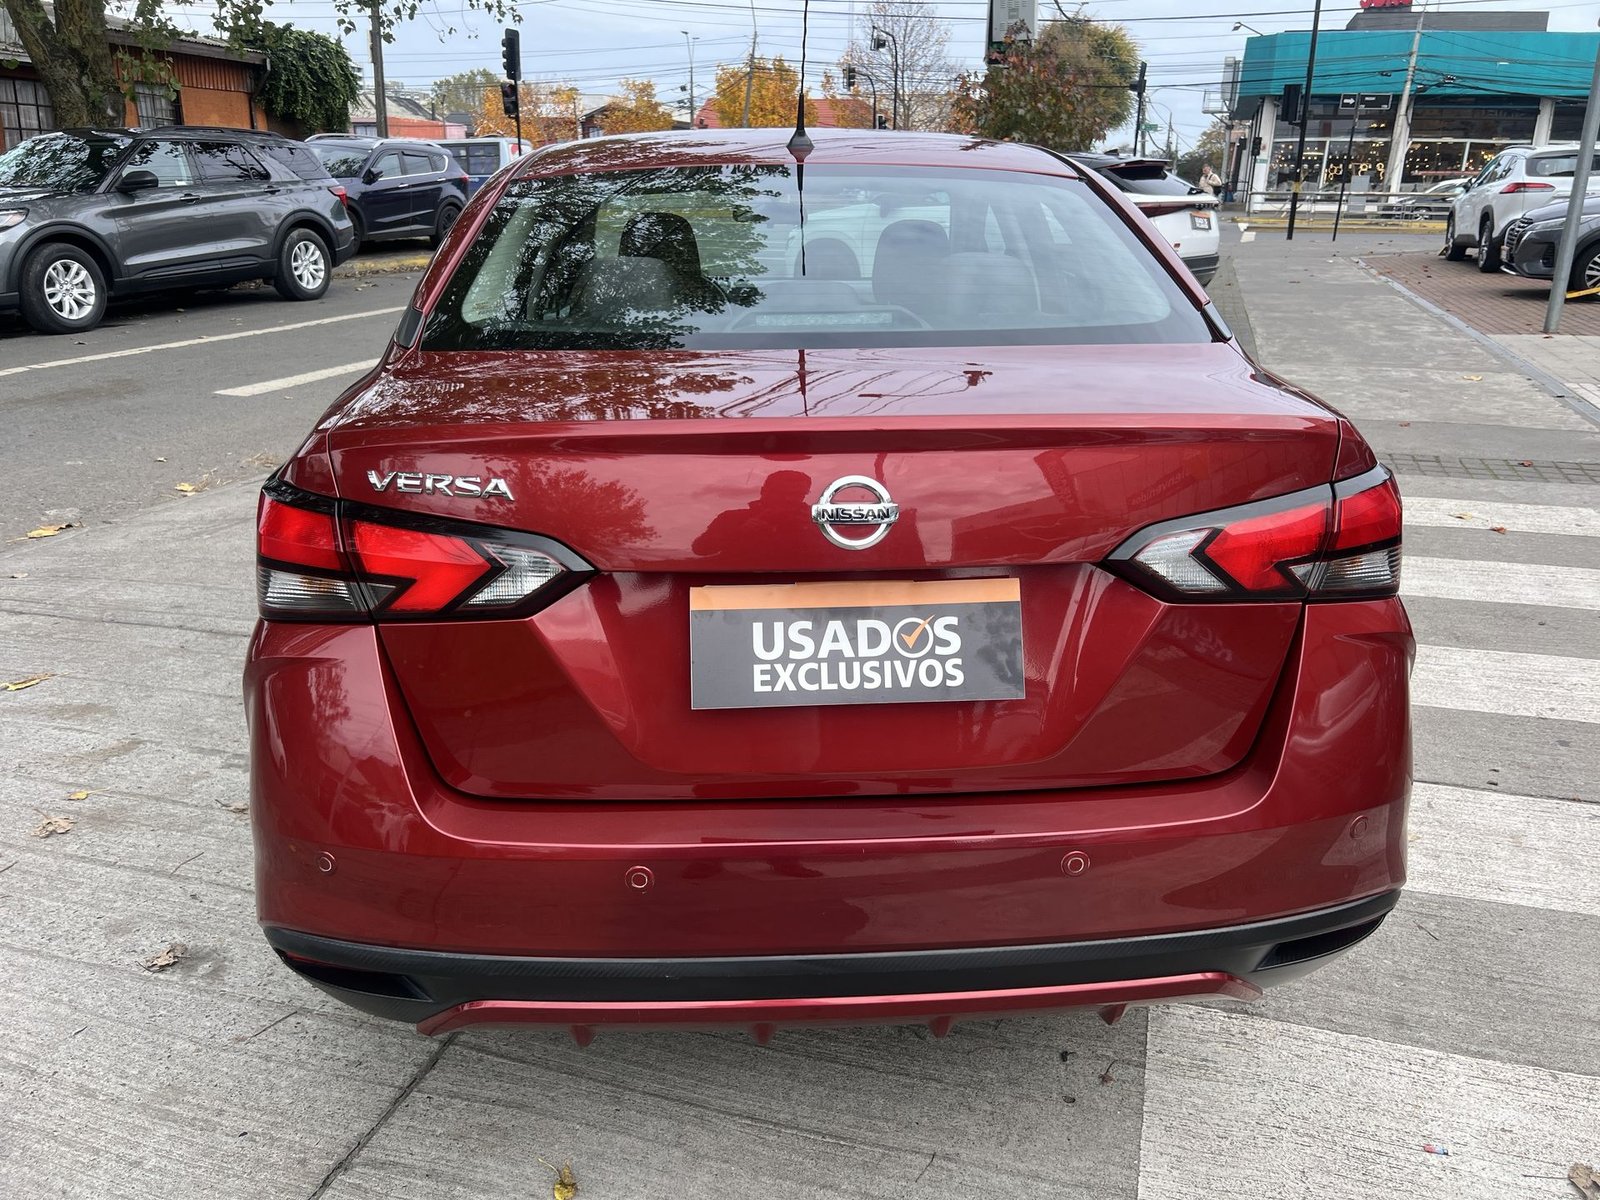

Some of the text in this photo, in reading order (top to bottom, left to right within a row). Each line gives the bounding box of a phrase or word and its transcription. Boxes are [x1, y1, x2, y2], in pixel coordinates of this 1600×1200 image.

[367, 470, 515, 501] VERSA
[821, 507, 890, 521] NISSAN
[752, 615, 962, 659] USADOS
[752, 658, 965, 692] EXCLUSIVOS
